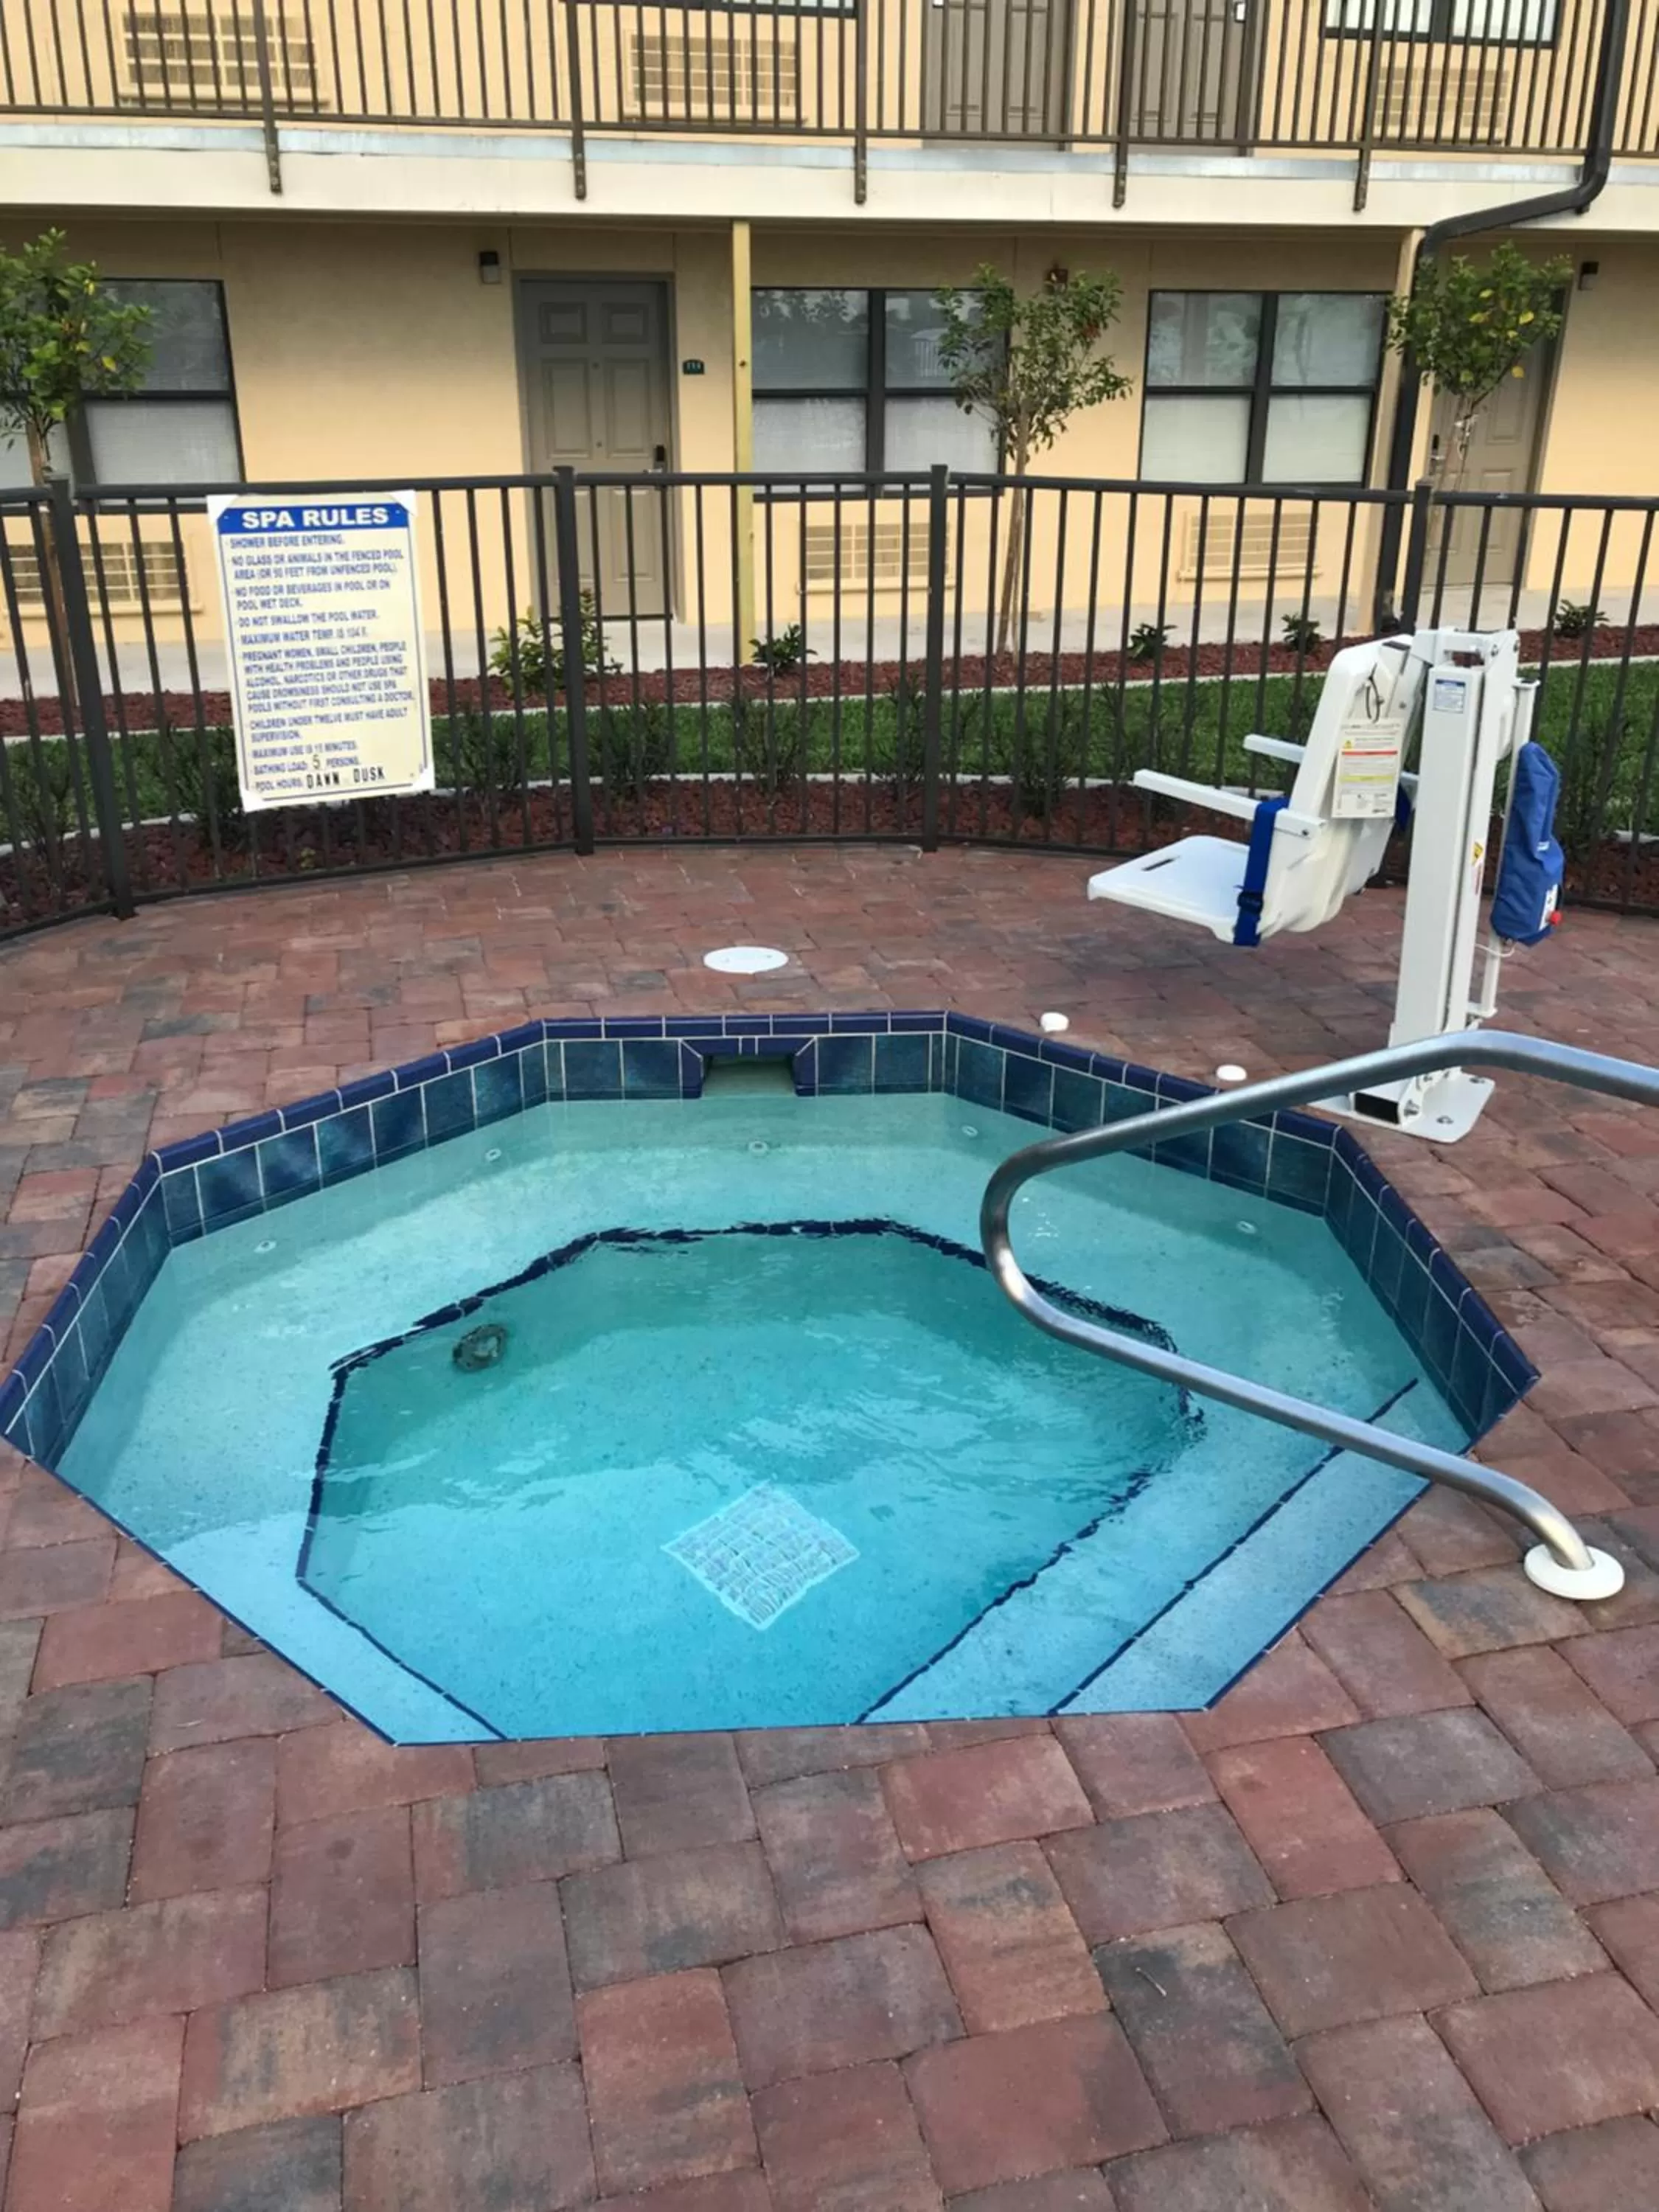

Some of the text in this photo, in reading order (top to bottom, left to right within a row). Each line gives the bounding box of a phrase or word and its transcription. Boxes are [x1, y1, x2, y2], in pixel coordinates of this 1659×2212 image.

[242, 507, 389, 529] SPA RULES
[268, 535, 299, 546] BEFORE
[232, 556, 243, 566] NO
[274, 554, 285, 563] OR
[324, 552, 332, 561] IN
[335, 552, 349, 561] THE
[352, 550, 380, 560] FENCED
[234, 569, 255, 579] AREA
[285, 567, 304, 577] FEET
[307, 566, 327, 575] FROM
[235, 580, 390, 597] NO FOOD OR BEVERAGES IN POOL OR ON
[237, 600, 258, 611] POOL
[260, 599, 276, 609] WET
[238, 617, 250, 627] DO
[253, 616, 268, 626] NOT
[271, 613, 309, 625] SWALLOW
[312, 613, 326, 622] THE
[329, 611, 349, 621] POOL
[283, 630, 309, 641] WATER
[380, 641, 406, 651] PEOPLE
[244, 664, 262, 674] WITH
[265, 661, 293, 672] HEALTH
[247, 689, 270, 700] CAUSE
[352, 681, 366, 692] NOT
[309, 697, 329, 708] FIRST
[386, 707, 407, 717] ADULT
[313, 754, 321, 769] 5
[306, 770, 340, 789] DAWN
[353, 765, 385, 783] DUSK
